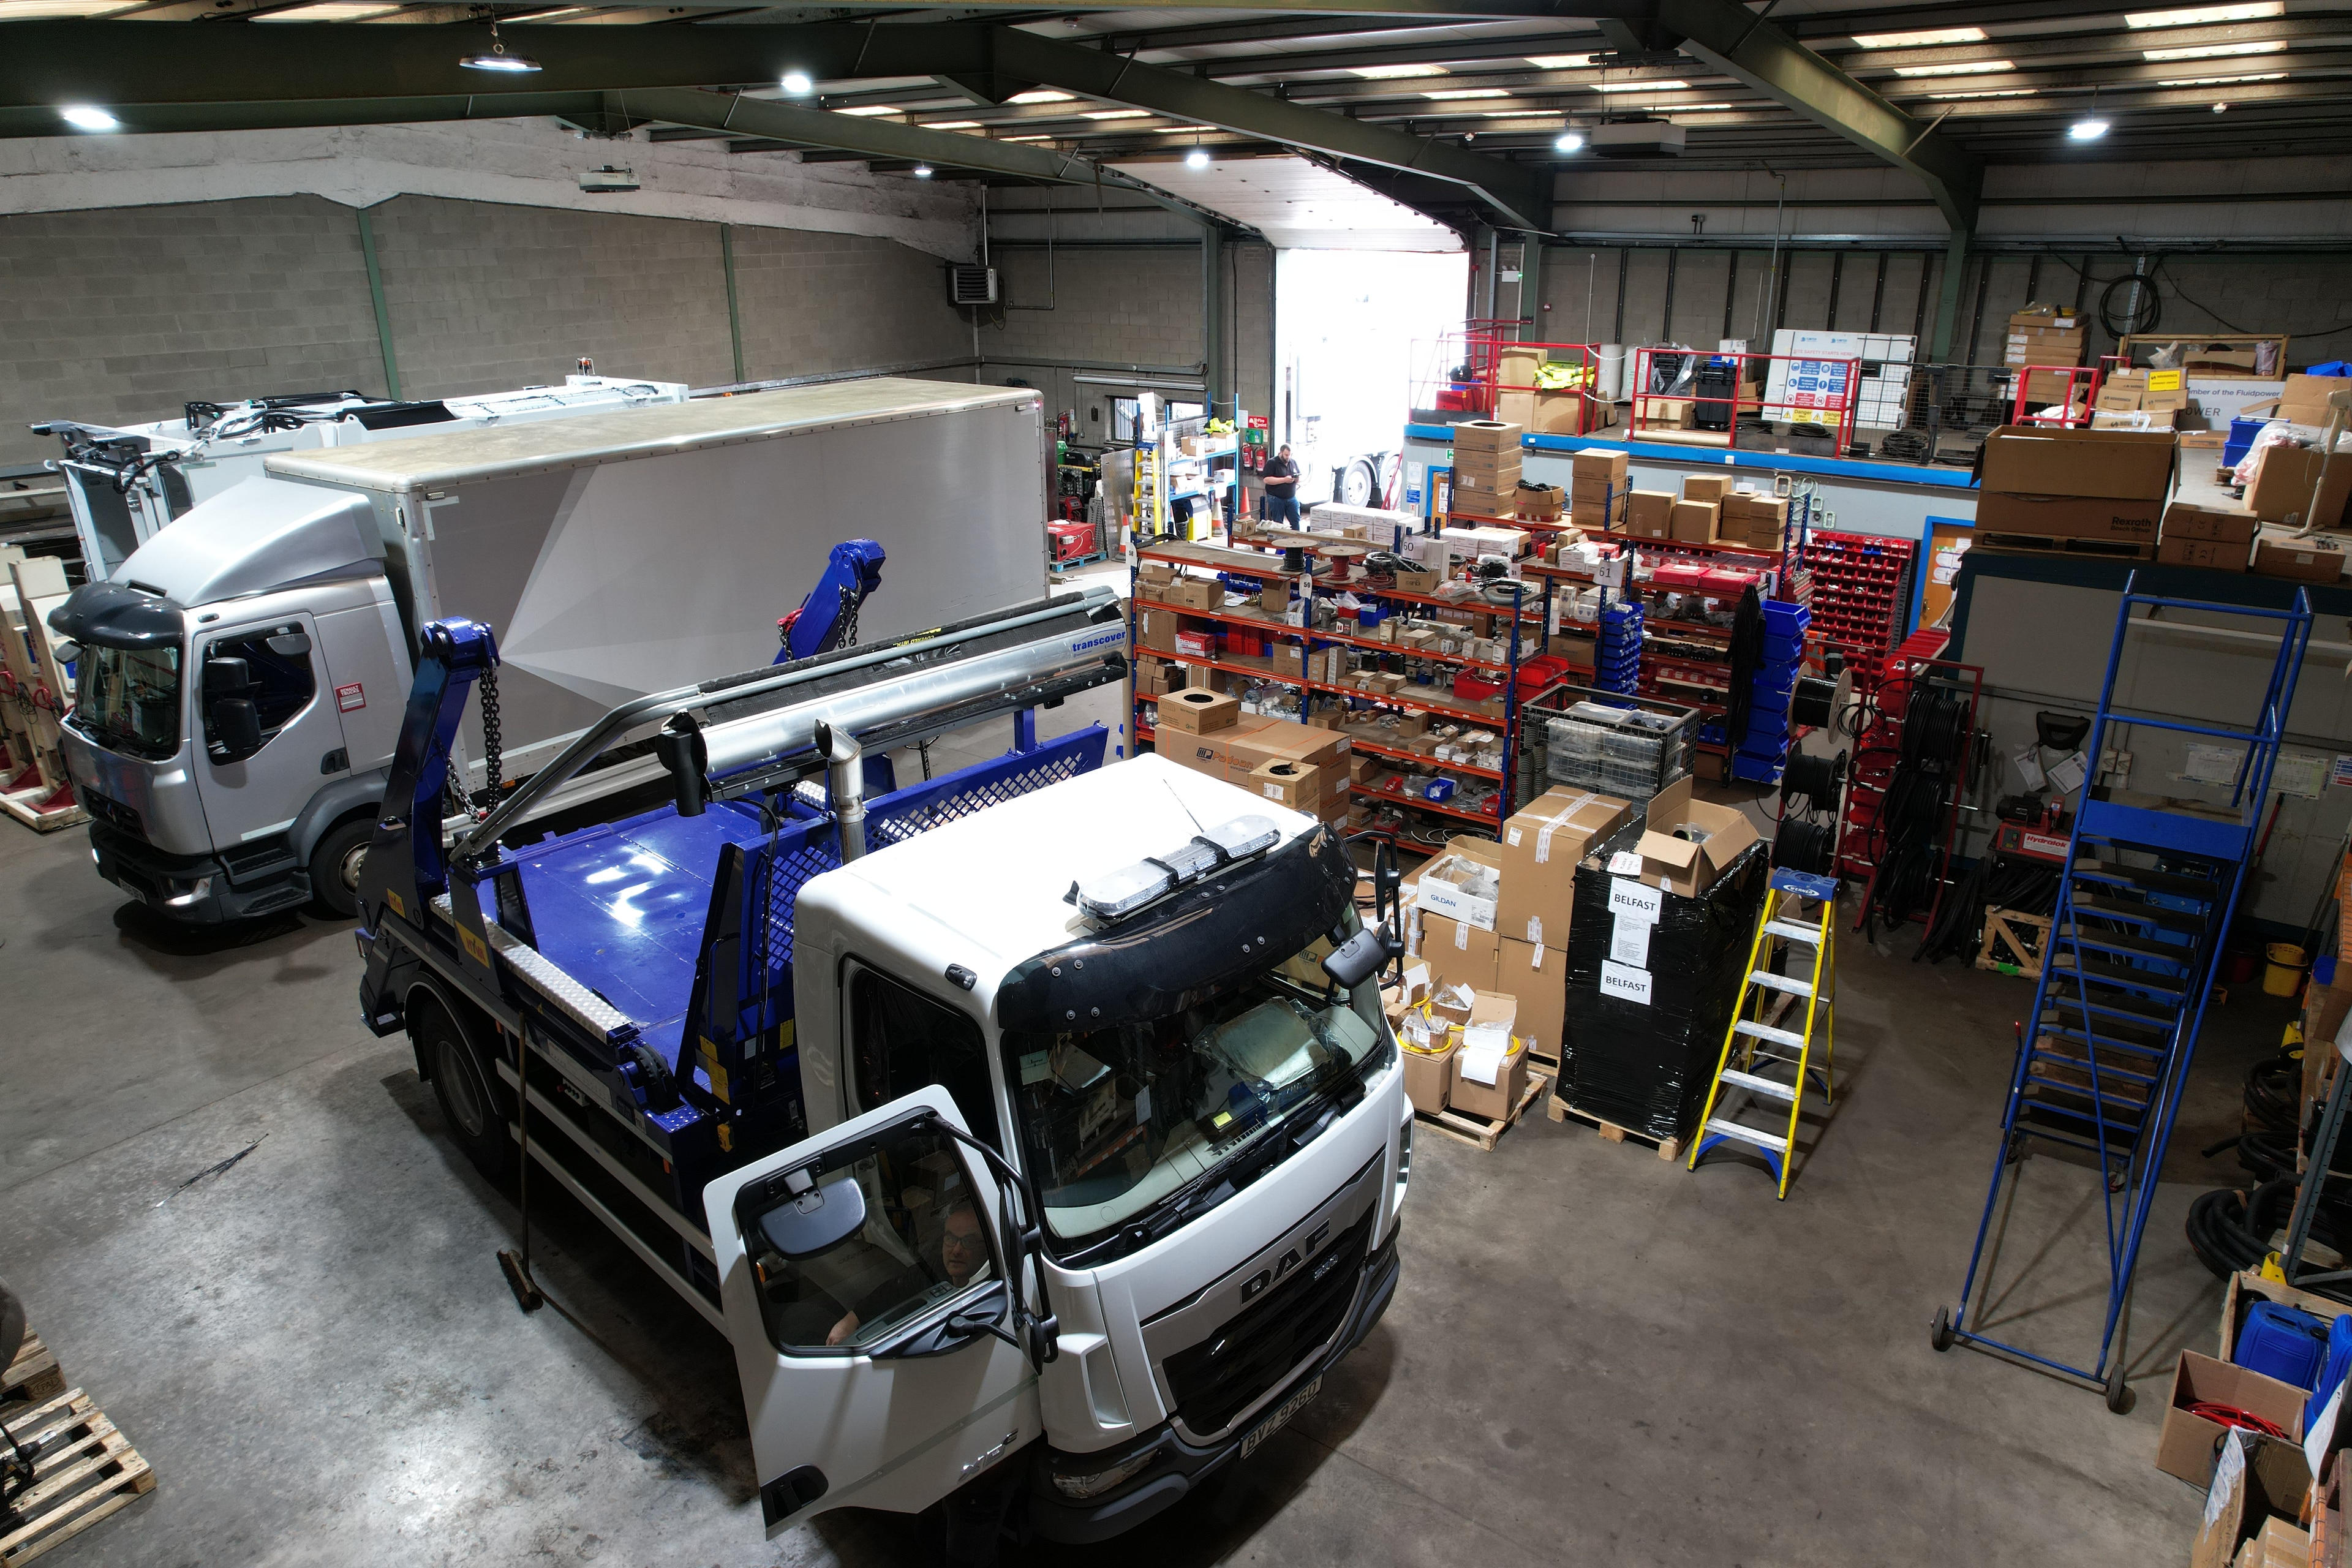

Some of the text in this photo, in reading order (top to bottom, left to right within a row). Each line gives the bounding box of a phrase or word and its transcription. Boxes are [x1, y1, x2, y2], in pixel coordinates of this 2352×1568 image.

[2185, 407, 2221, 416] OWER
[2112, 516, 2152, 527] Rexroth
[1403, 541, 1414, 551] 60
[1599, 567, 1611, 578] 61
[1072, 631, 1126, 652] transcover
[1212, 751, 1254, 770] Padoan
[2027, 835, 2067, 848] Hydralok
[1431, 894, 1456, 907] GILDAN
[1615, 894, 1656, 911] BELFAST
[466, 937, 486, 963] HYVA
[1605, 976, 1646, 992] BELFAST
[1240, 1218, 1330, 1306] DAF
[1246, 1381, 1317, 1452] BVZ 9260
